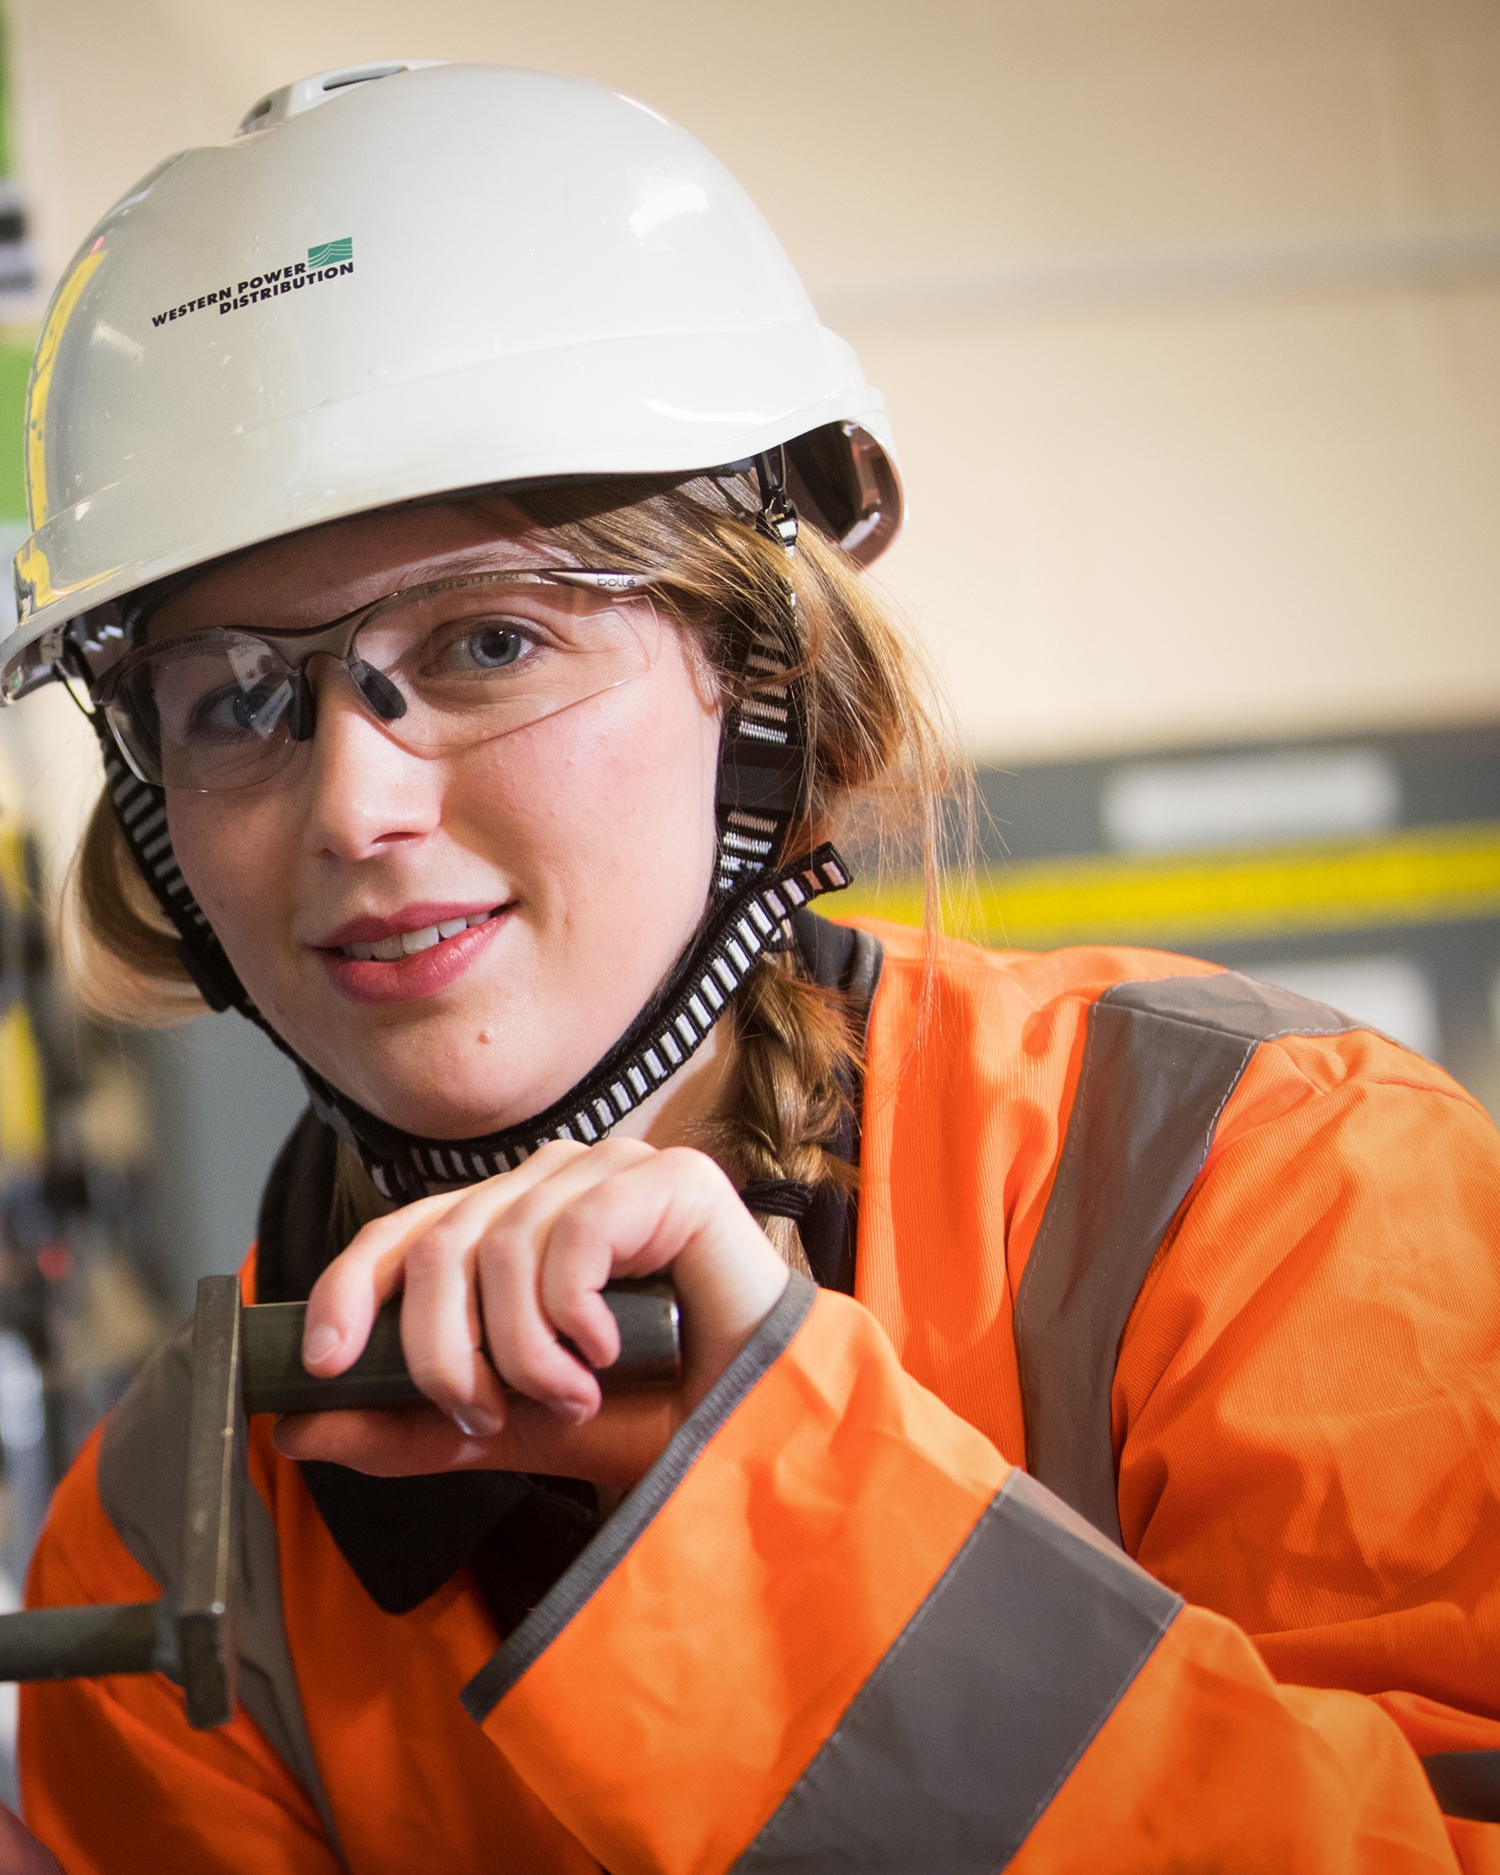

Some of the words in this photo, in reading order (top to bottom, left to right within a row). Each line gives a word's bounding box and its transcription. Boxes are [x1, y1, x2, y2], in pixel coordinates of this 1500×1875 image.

[151, 286, 232, 327] WESTERN
[238, 262, 307, 294] POWER
[219, 261, 354, 315] DISTRIBUTION
